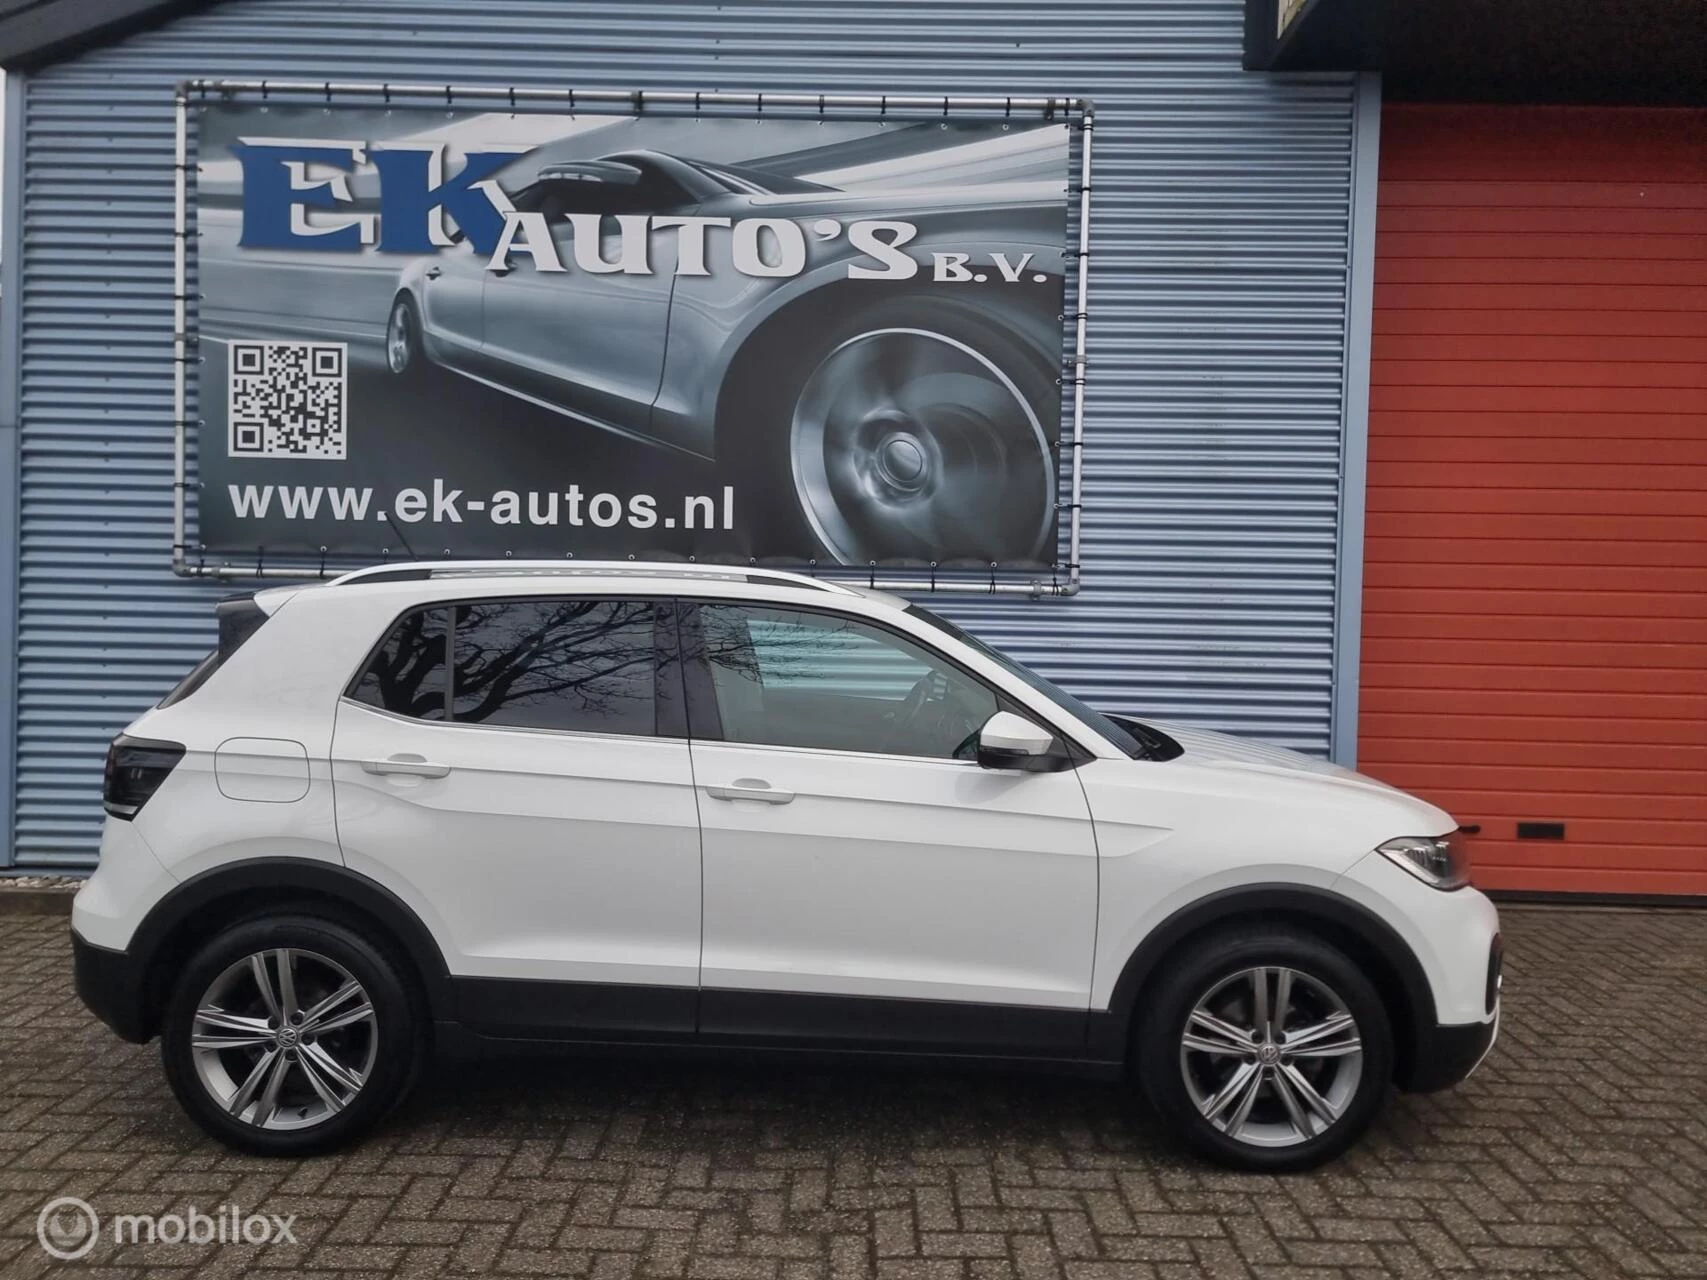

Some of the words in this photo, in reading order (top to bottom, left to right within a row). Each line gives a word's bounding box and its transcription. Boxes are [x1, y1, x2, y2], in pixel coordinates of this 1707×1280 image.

[232, 136, 539, 255] EK
[932, 251, 1048, 283] B.V.
[228, 479, 735, 530] www.ek-autos.nl
